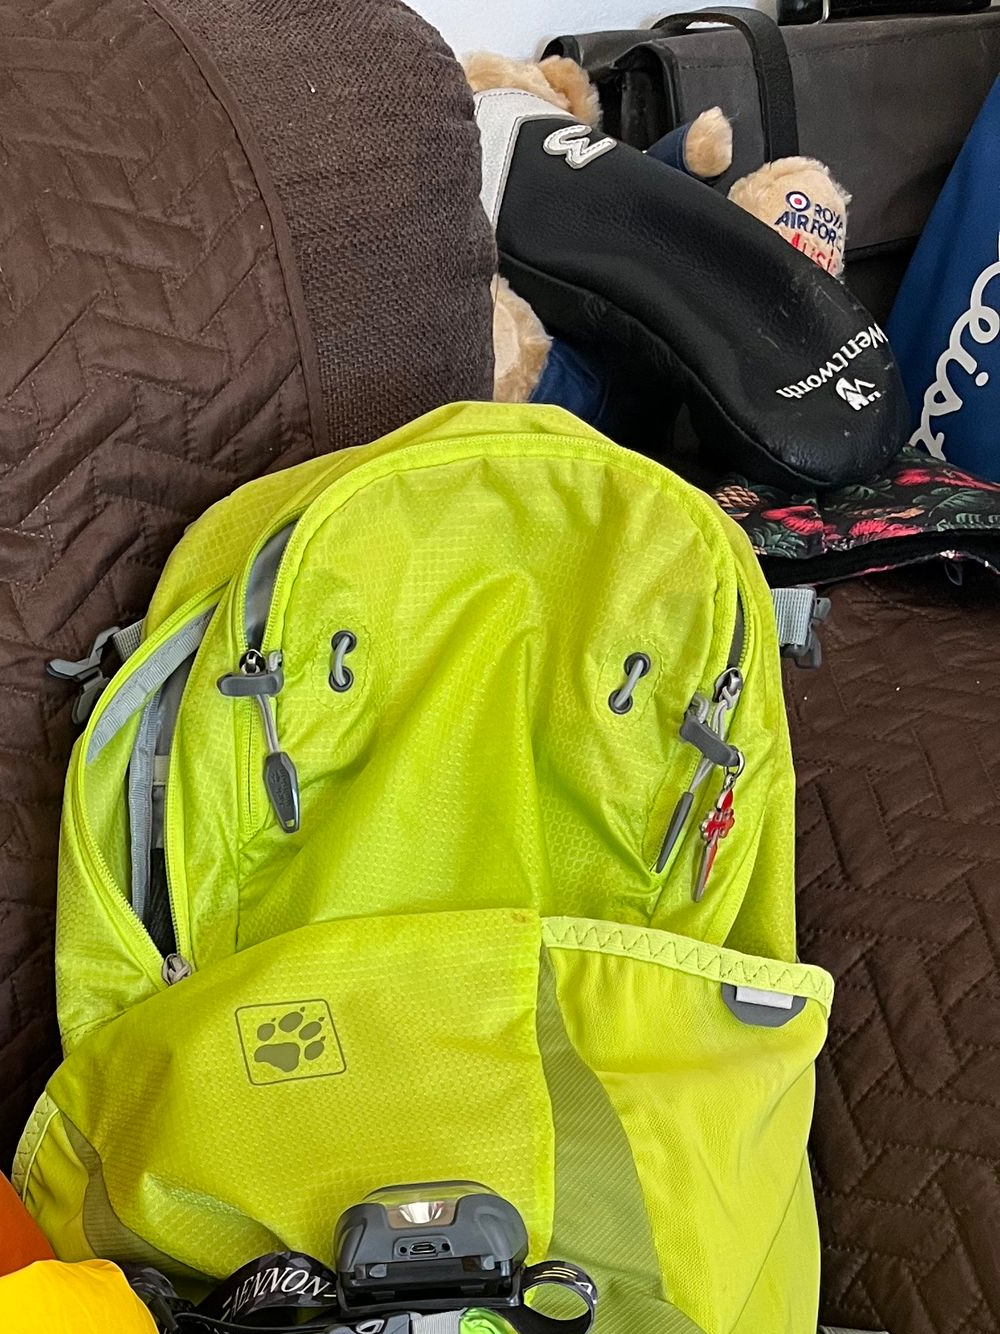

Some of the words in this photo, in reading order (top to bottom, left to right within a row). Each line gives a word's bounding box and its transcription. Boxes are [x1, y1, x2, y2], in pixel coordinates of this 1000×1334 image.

[774, 211, 809, 234] AIR
[811, 219, 841, 250] FOR
[813, 203, 844, 230] ROYA
[776, 322, 889, 399] Wentworth
